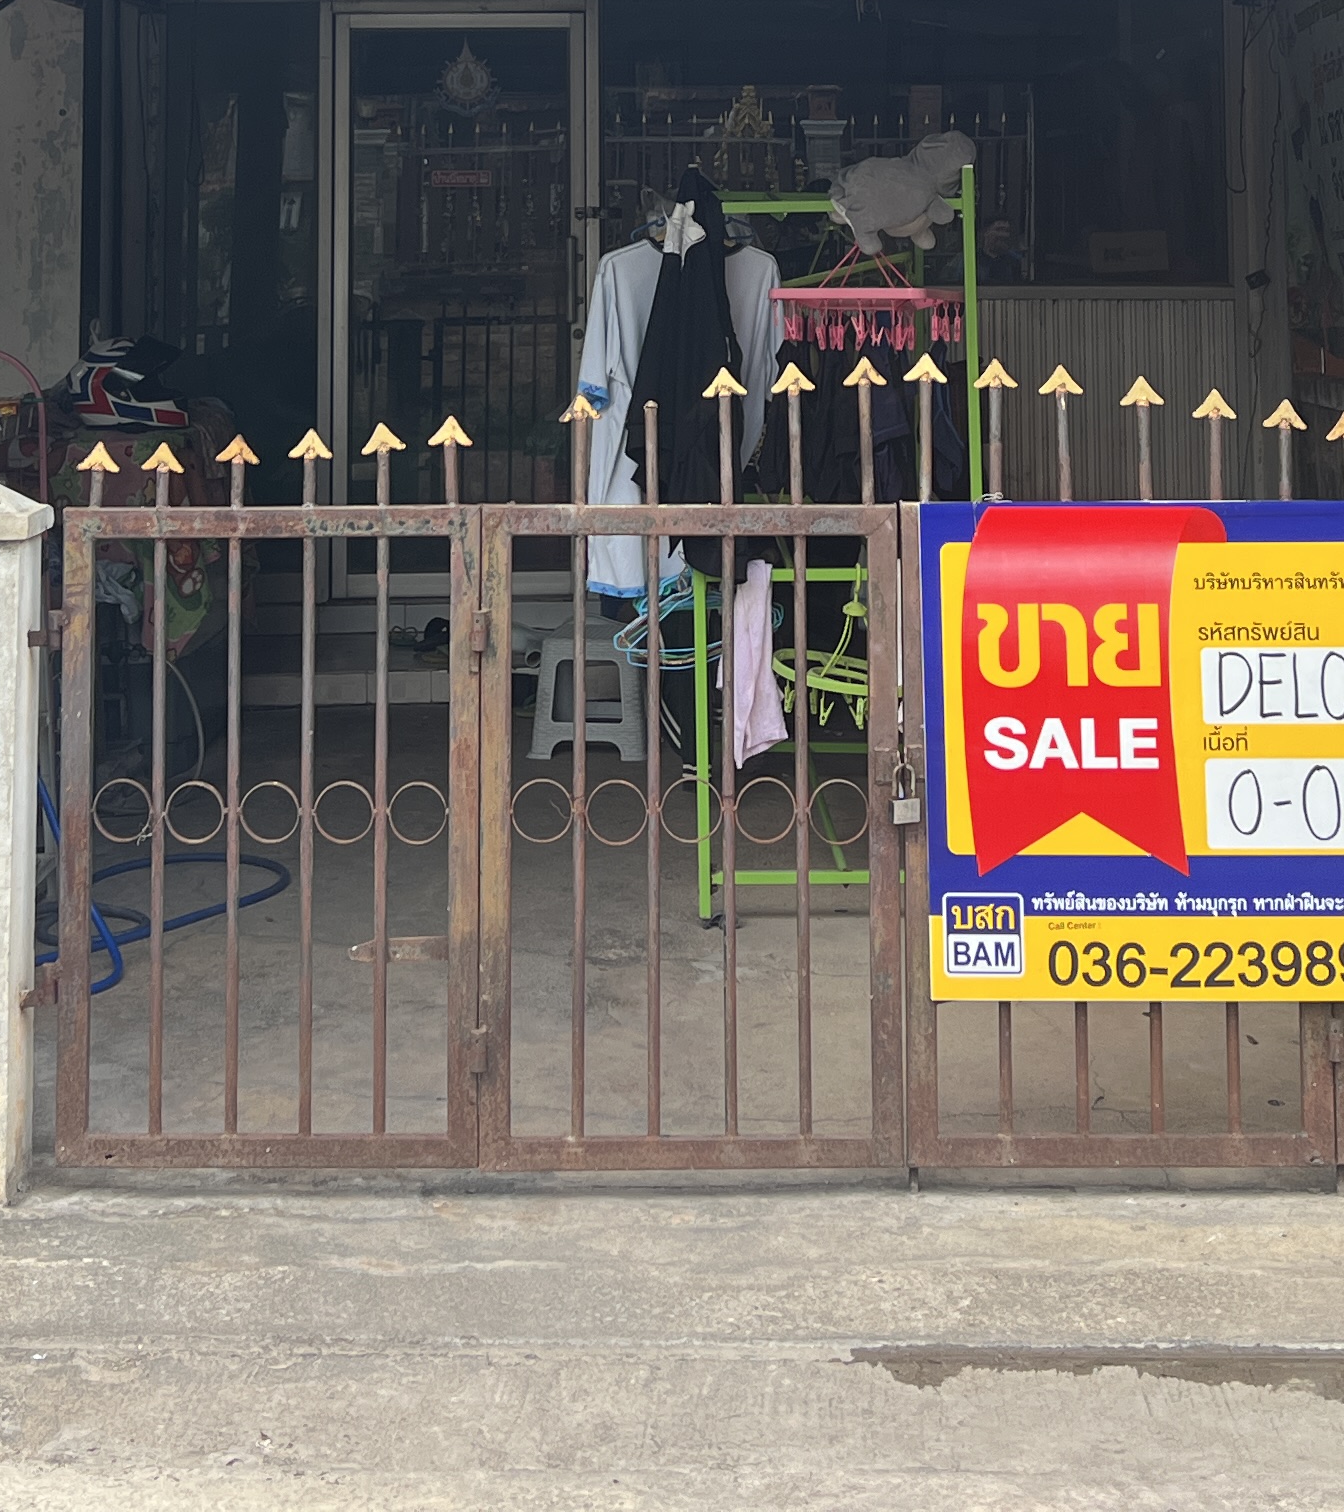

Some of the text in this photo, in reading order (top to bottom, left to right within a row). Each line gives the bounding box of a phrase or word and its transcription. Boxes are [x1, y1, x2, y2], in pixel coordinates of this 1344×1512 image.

[1198, 621, 1320, 641] รหัสทรัพย์สิน
[977, 603, 1162, 688] ขาย
[984, 716, 1159, 770] SALE
[1203, 726, 1249, 752] เนื้อที่
[1031, 890, 1168, 911] ทรัพย์สินของบริษัท
[1175, 892, 1247, 916] ห้ามบุกรุก
[951, 902, 1015, 931] บสก
[953, 941, 1016, 967] BAM
